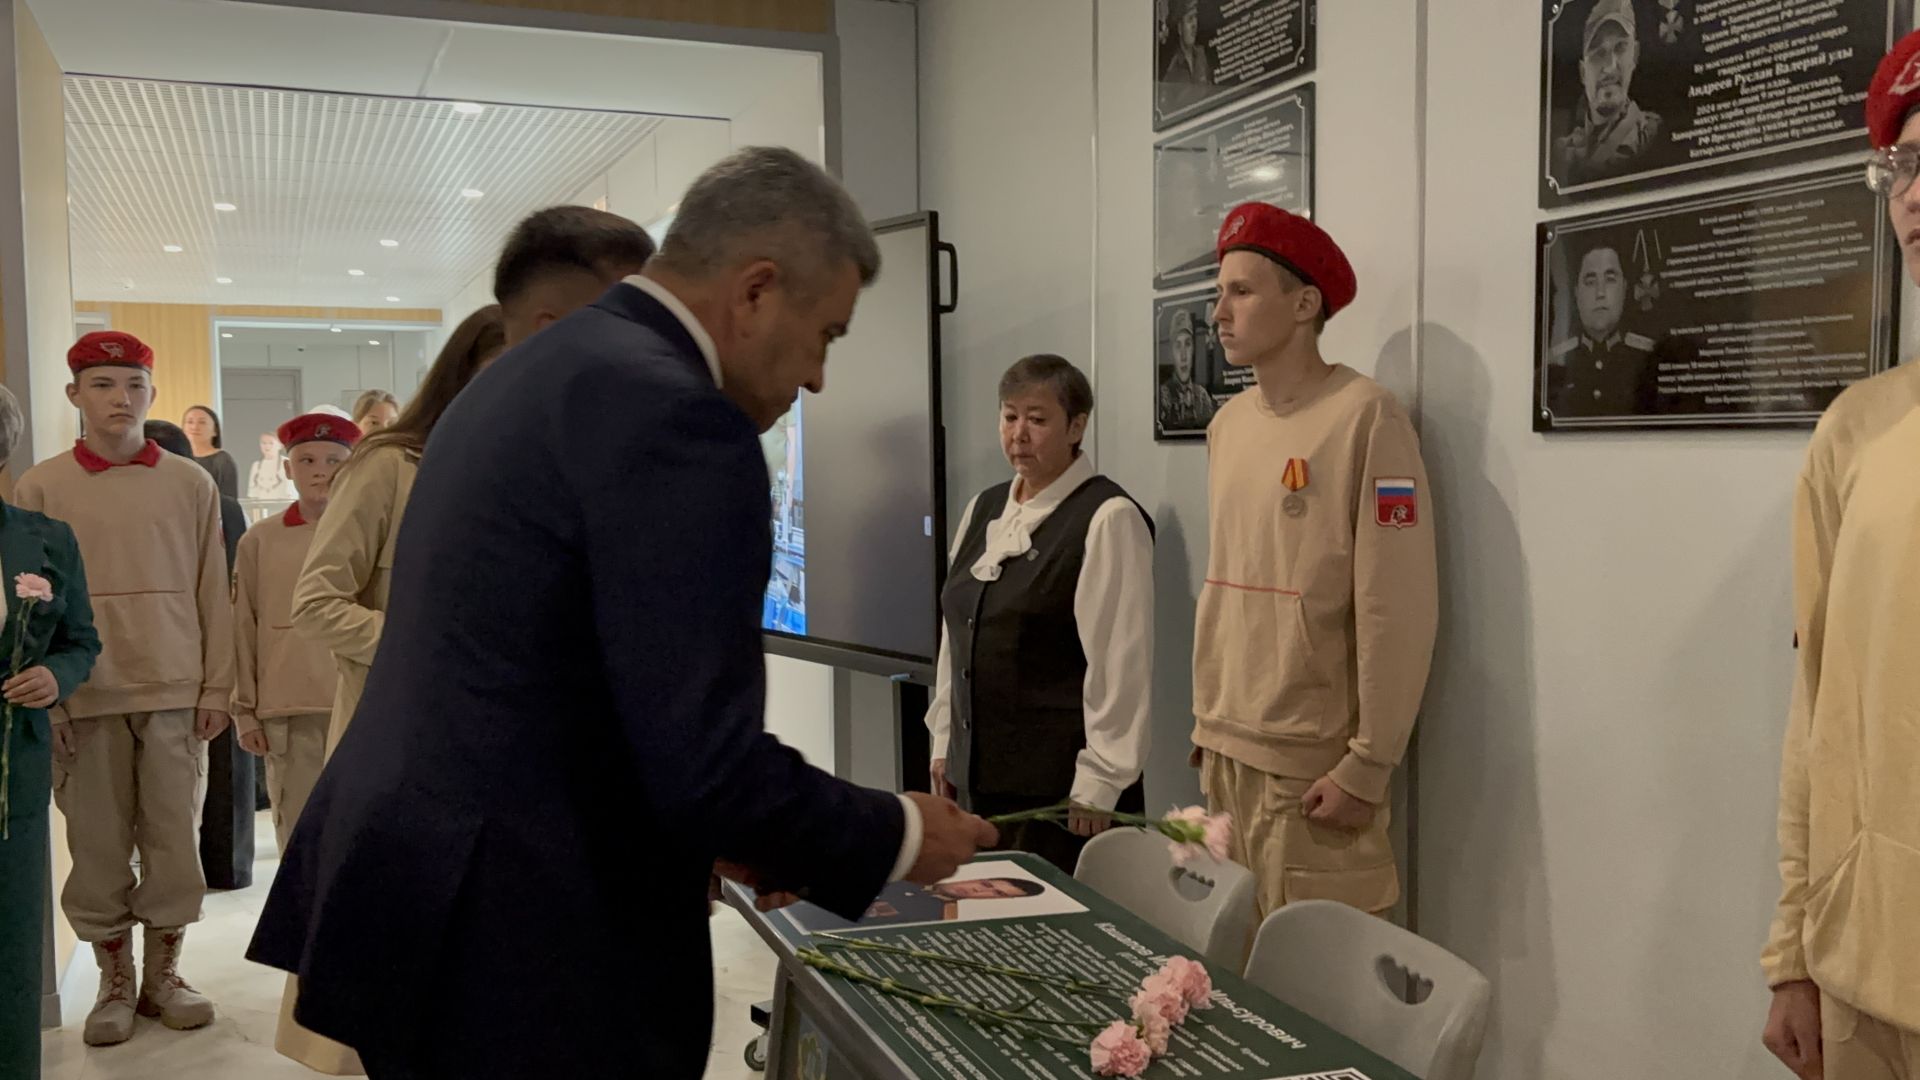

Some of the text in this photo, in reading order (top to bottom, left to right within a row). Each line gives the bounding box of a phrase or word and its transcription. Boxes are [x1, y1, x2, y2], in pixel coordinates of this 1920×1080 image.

[1688, 47, 1853, 97] Андреев Руслан Валерий улы
[1696, 103, 1715, 116] 2024
[1210, 989, 1306, 1049] Ильсурович
